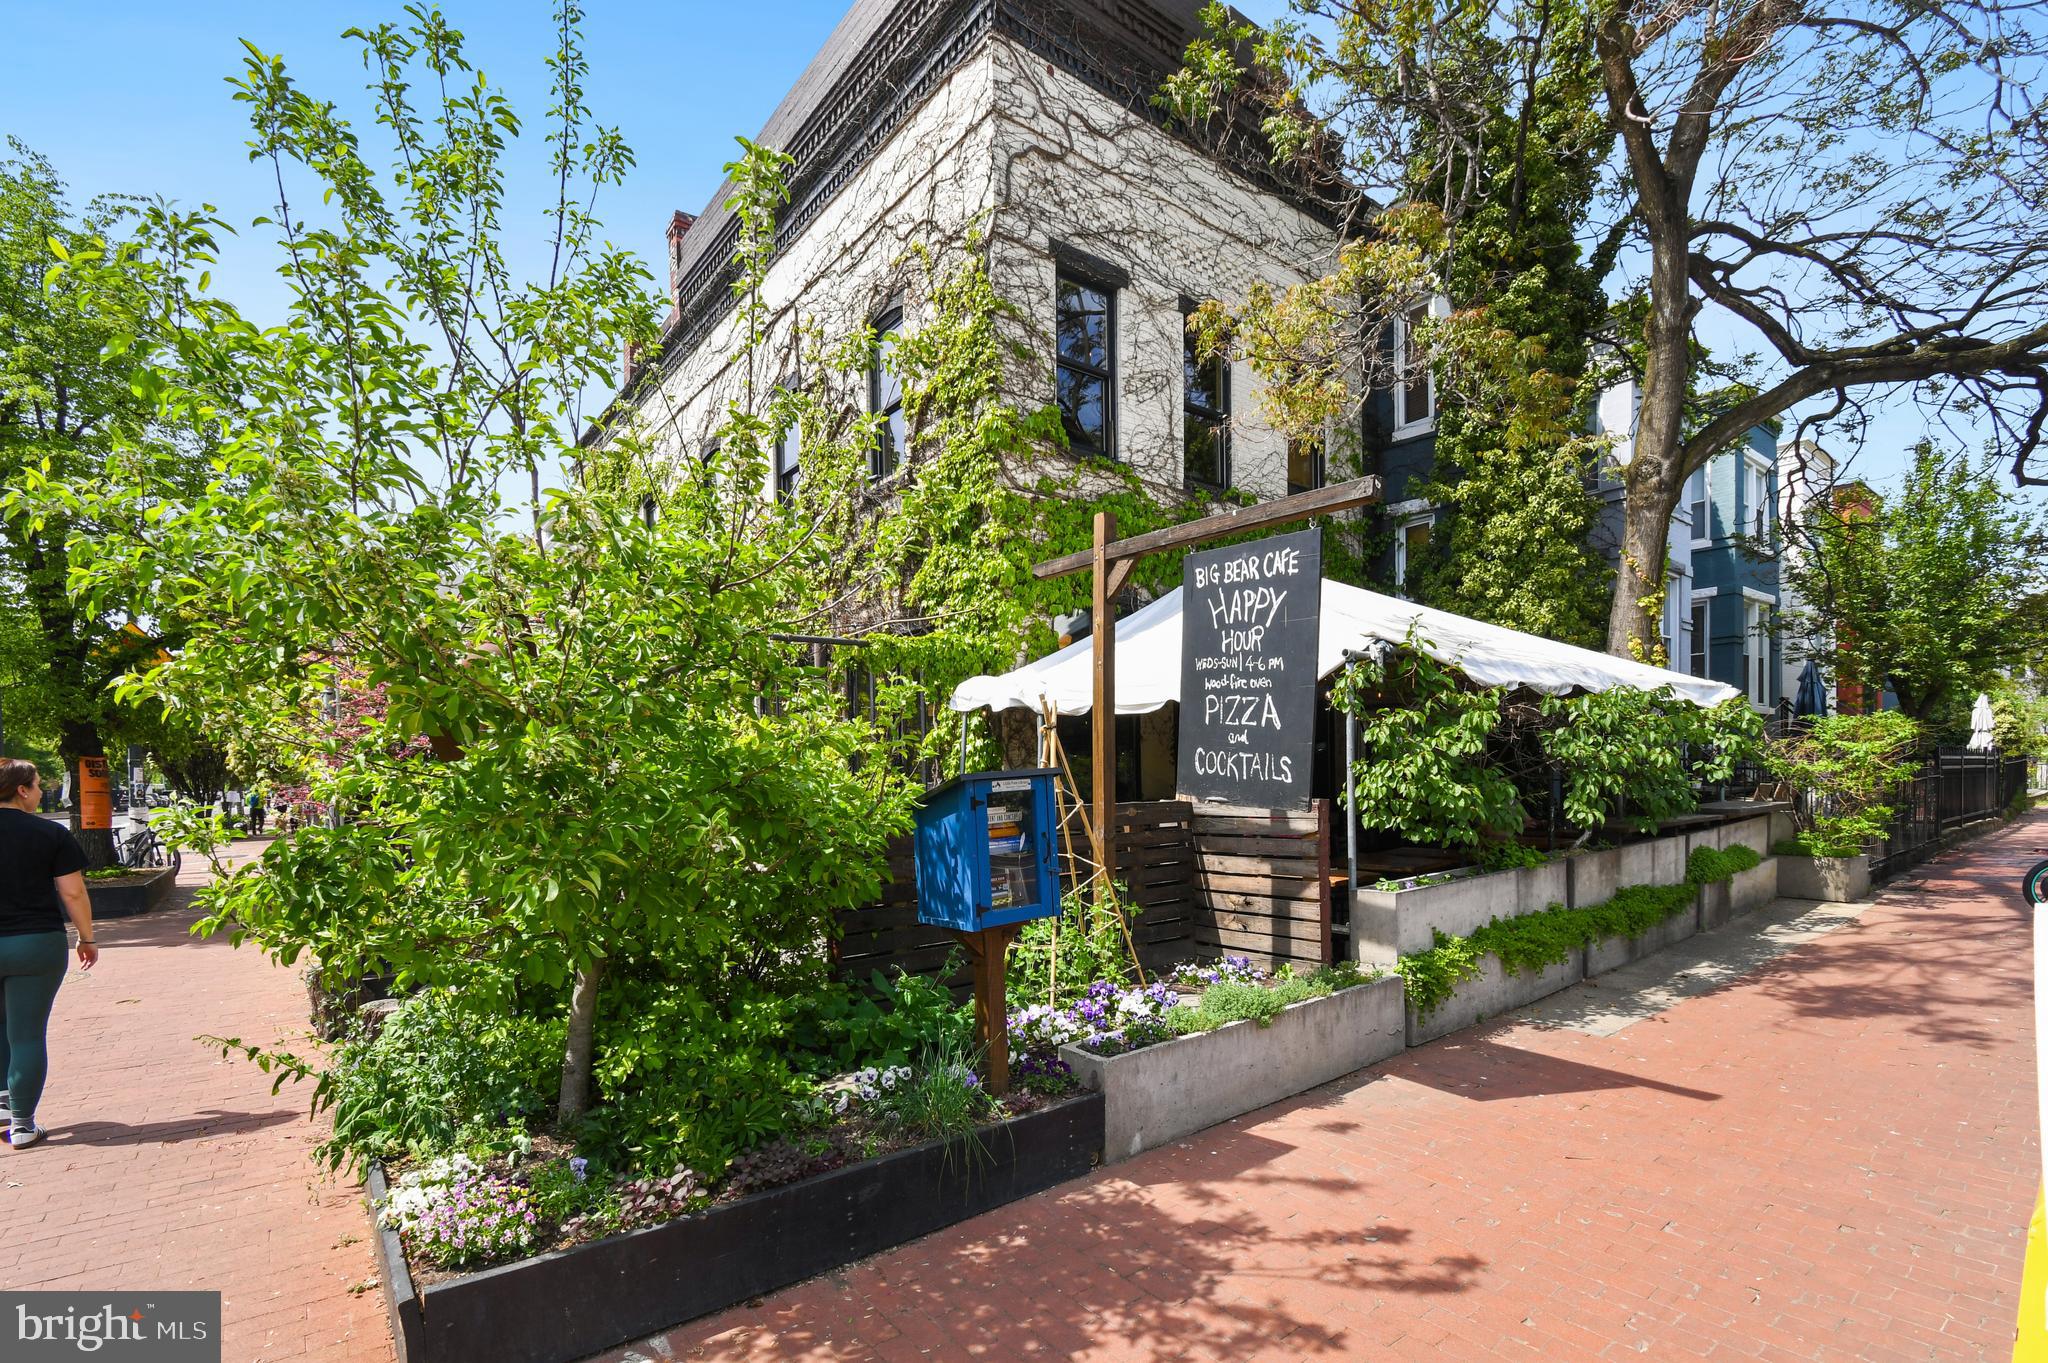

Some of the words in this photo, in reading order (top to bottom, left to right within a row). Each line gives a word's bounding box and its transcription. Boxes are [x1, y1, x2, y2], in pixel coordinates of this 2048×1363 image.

[1195, 564, 1220, 589] BIG
[1223, 556, 1260, 583] BEAR
[1263, 547, 1300, 578] CAFE
[1208, 586, 1287, 630] HAPPY
[1222, 625, 1264, 655] HOUR
[1245, 655, 1266, 672] 4-6
[1268, 656, 1284, 671] PM
[1204, 673, 1248, 690] wood-fire
[1249, 676, 1273, 688] oven
[1205, 693, 1282, 731] PIZZA
[1227, 729, 1249, 745] and
[1194, 747, 1293, 784] COCKTAILS
